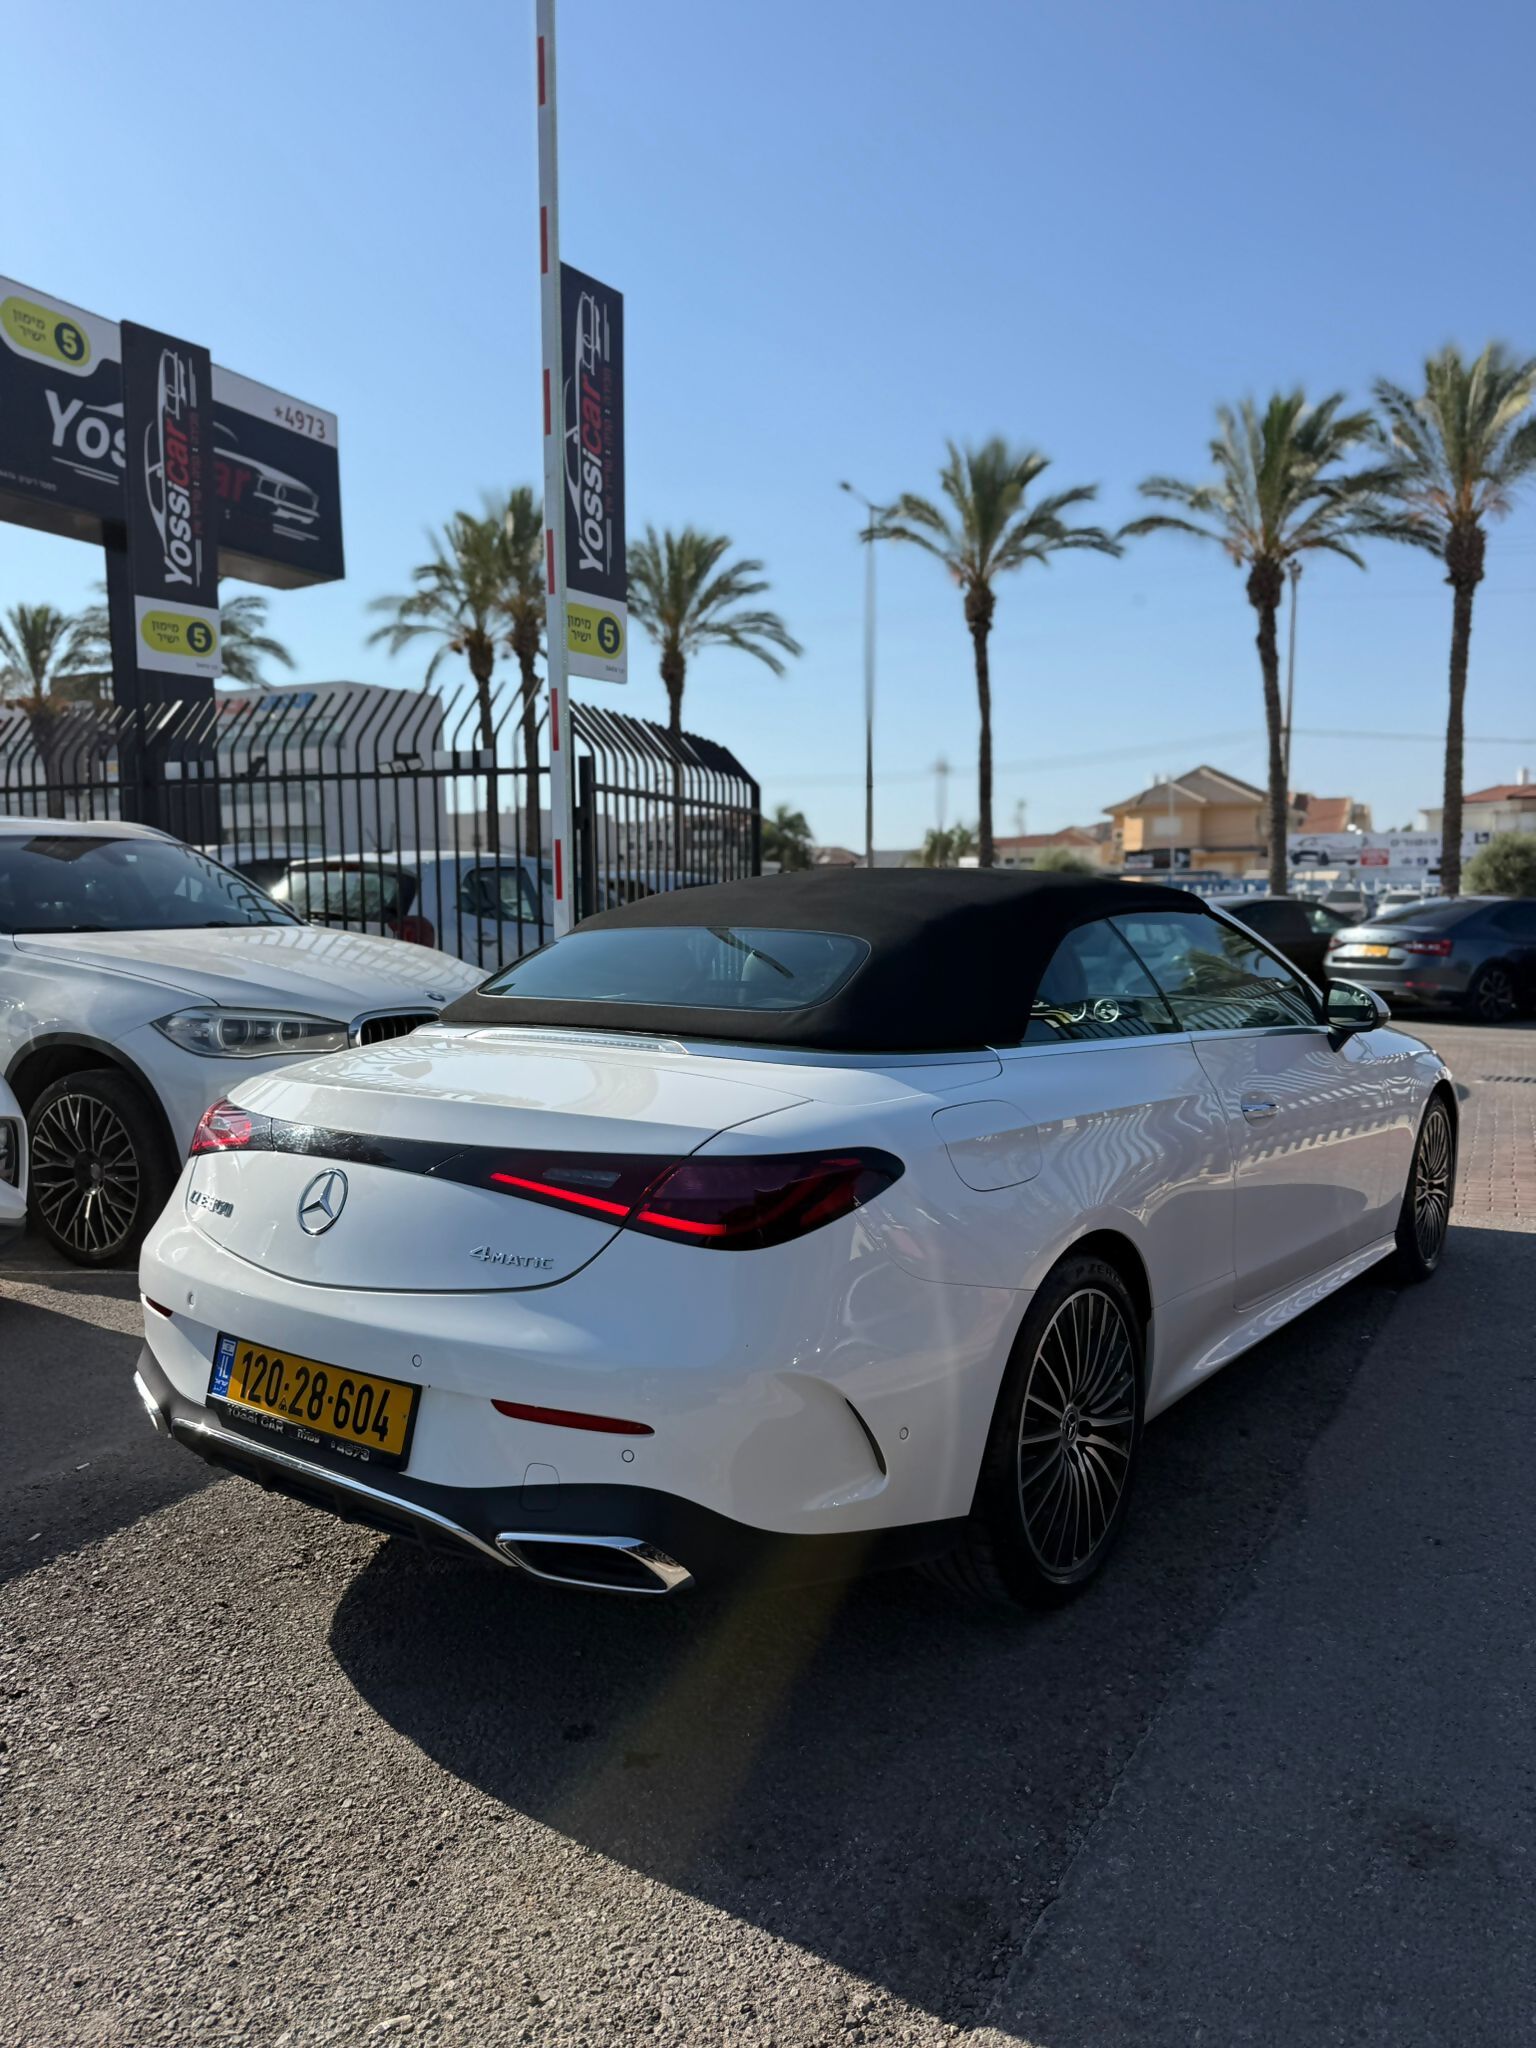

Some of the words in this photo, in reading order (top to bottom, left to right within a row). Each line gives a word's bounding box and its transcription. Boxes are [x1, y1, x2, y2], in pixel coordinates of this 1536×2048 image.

[12, 308, 46, 330] מימון
[62, 328, 78, 355] 5
[579, 373, 604, 573] Yossicar
[165, 417, 193, 585] Yossicar
[151, 620, 180, 633] מימון
[193, 627, 207, 649] 5
[604, 623, 615, 648] 5
[469, 1245, 554, 1270] 4MATIC
